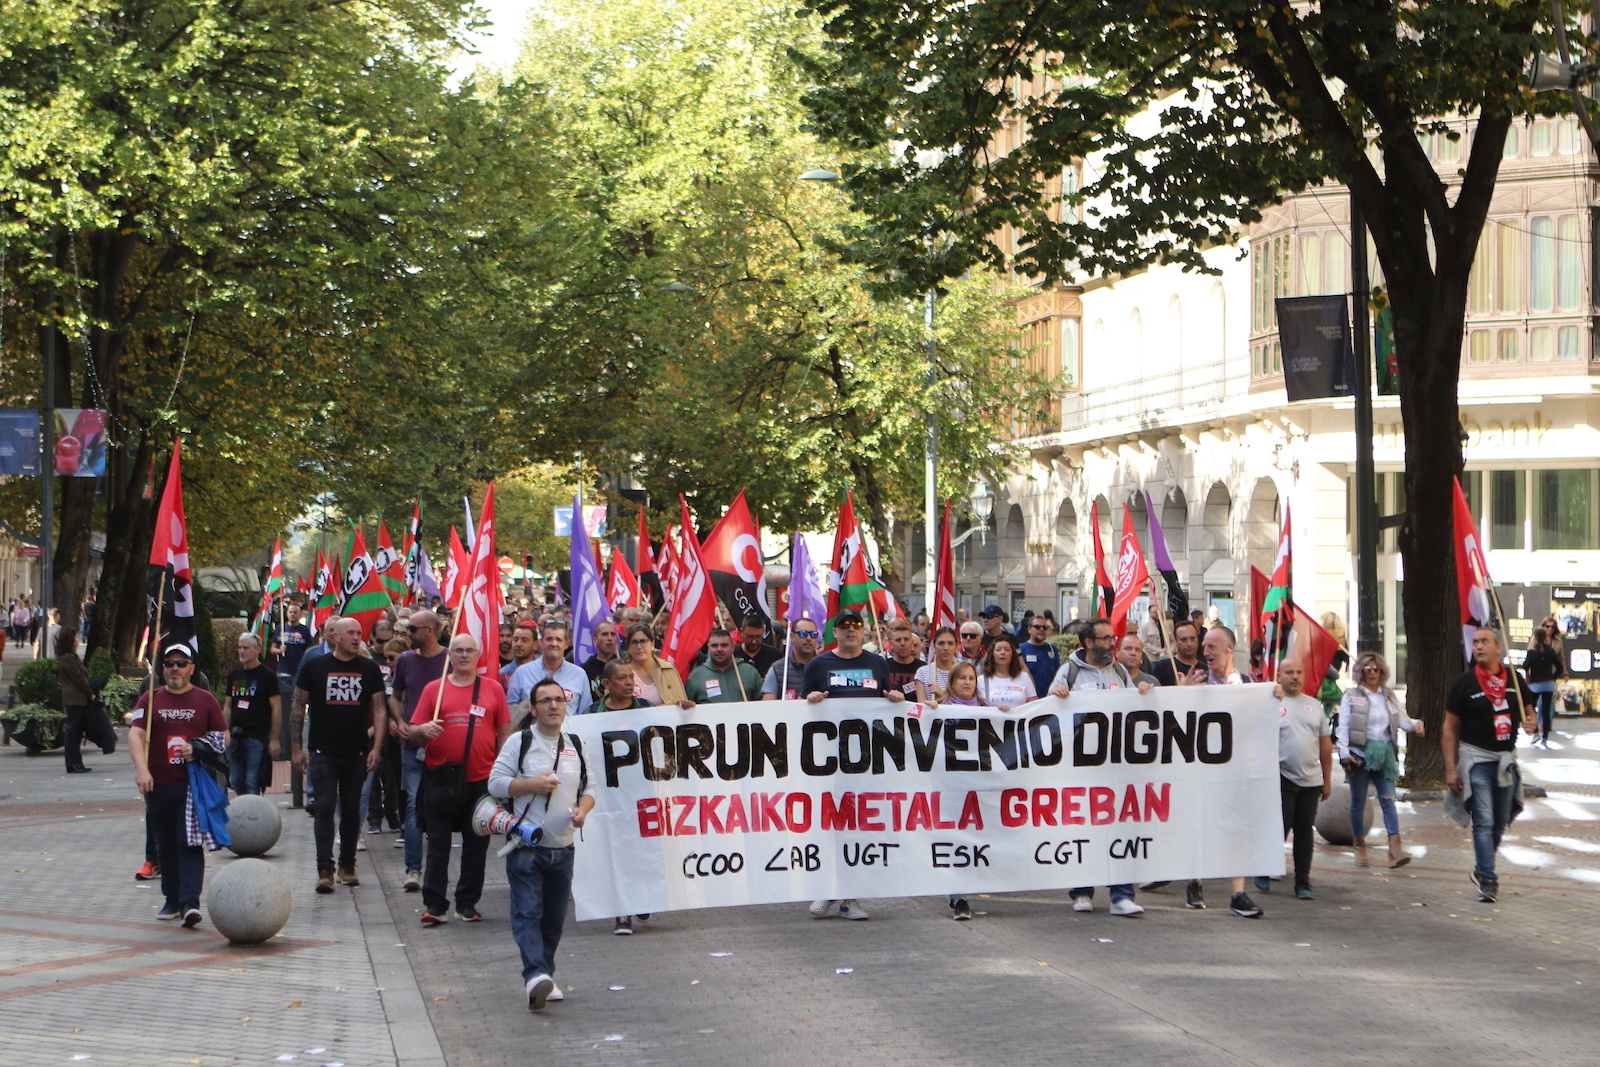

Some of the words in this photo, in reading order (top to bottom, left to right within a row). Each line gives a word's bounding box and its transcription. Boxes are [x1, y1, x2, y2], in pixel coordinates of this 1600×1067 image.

[326, 688, 362, 702] PNV
[327, 676, 362, 689] FCK
[800, 714, 1063, 776] CONVENIO
[1073, 710, 1233, 767] DIGNO
[636, 791, 812, 838] BIZKAIKO
[820, 790, 984, 832] METALA
[1000, 782, 1172, 828] GREBAN
[682, 852, 744, 879] CCOO
[765, 844, 821, 872] LAB
[844, 842, 900, 868] UGT
[931, 842, 991, 868] ESK
[1035, 839, 1091, 866] CGT
[1109, 837, 1154, 860] CNT
